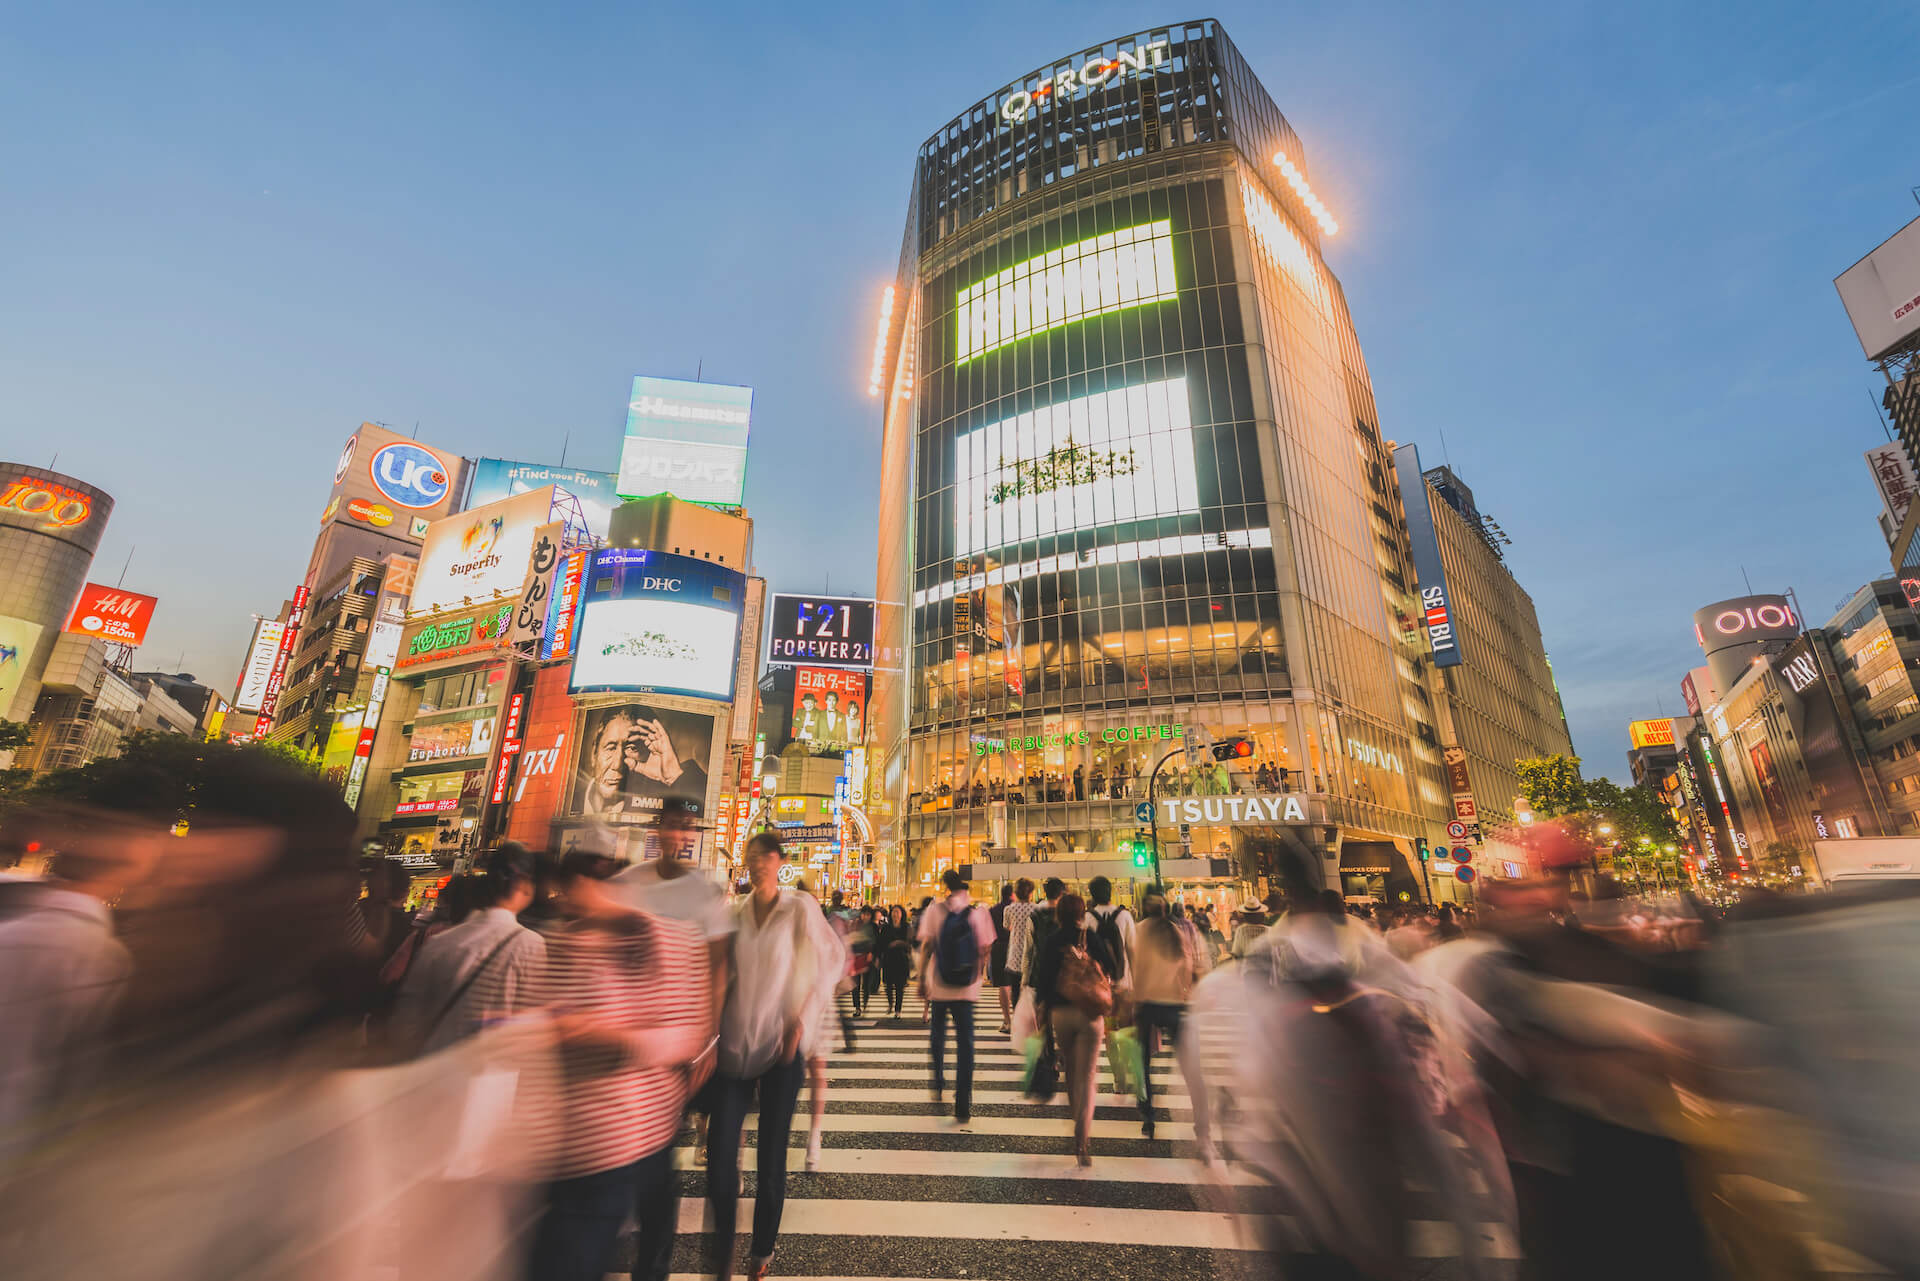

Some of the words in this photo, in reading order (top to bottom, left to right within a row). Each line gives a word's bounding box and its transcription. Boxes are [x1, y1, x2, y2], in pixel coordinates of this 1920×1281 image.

[380, 452, 443, 497] UC
[0, 482, 91, 528] 109
[449, 553, 502, 577] Superfly
[517, 536, 557, 637] もんじゃ
[642, 576, 682, 592] DHC
[93, 593, 143, 619] H&M
[1422, 585, 1454, 652] SEIBU
[102, 625, 136, 639] 150m
[796, 602, 851, 638] F21
[773, 638, 849, 659] FOREVER
[853, 643, 869, 660] 21
[798, 670, 864, 691] 日本ダービー
[975, 730, 1090, 756] STARBUCKS
[1102, 723, 1184, 743] COFFEE
[1162, 797, 1306, 823] TSUTAYA
